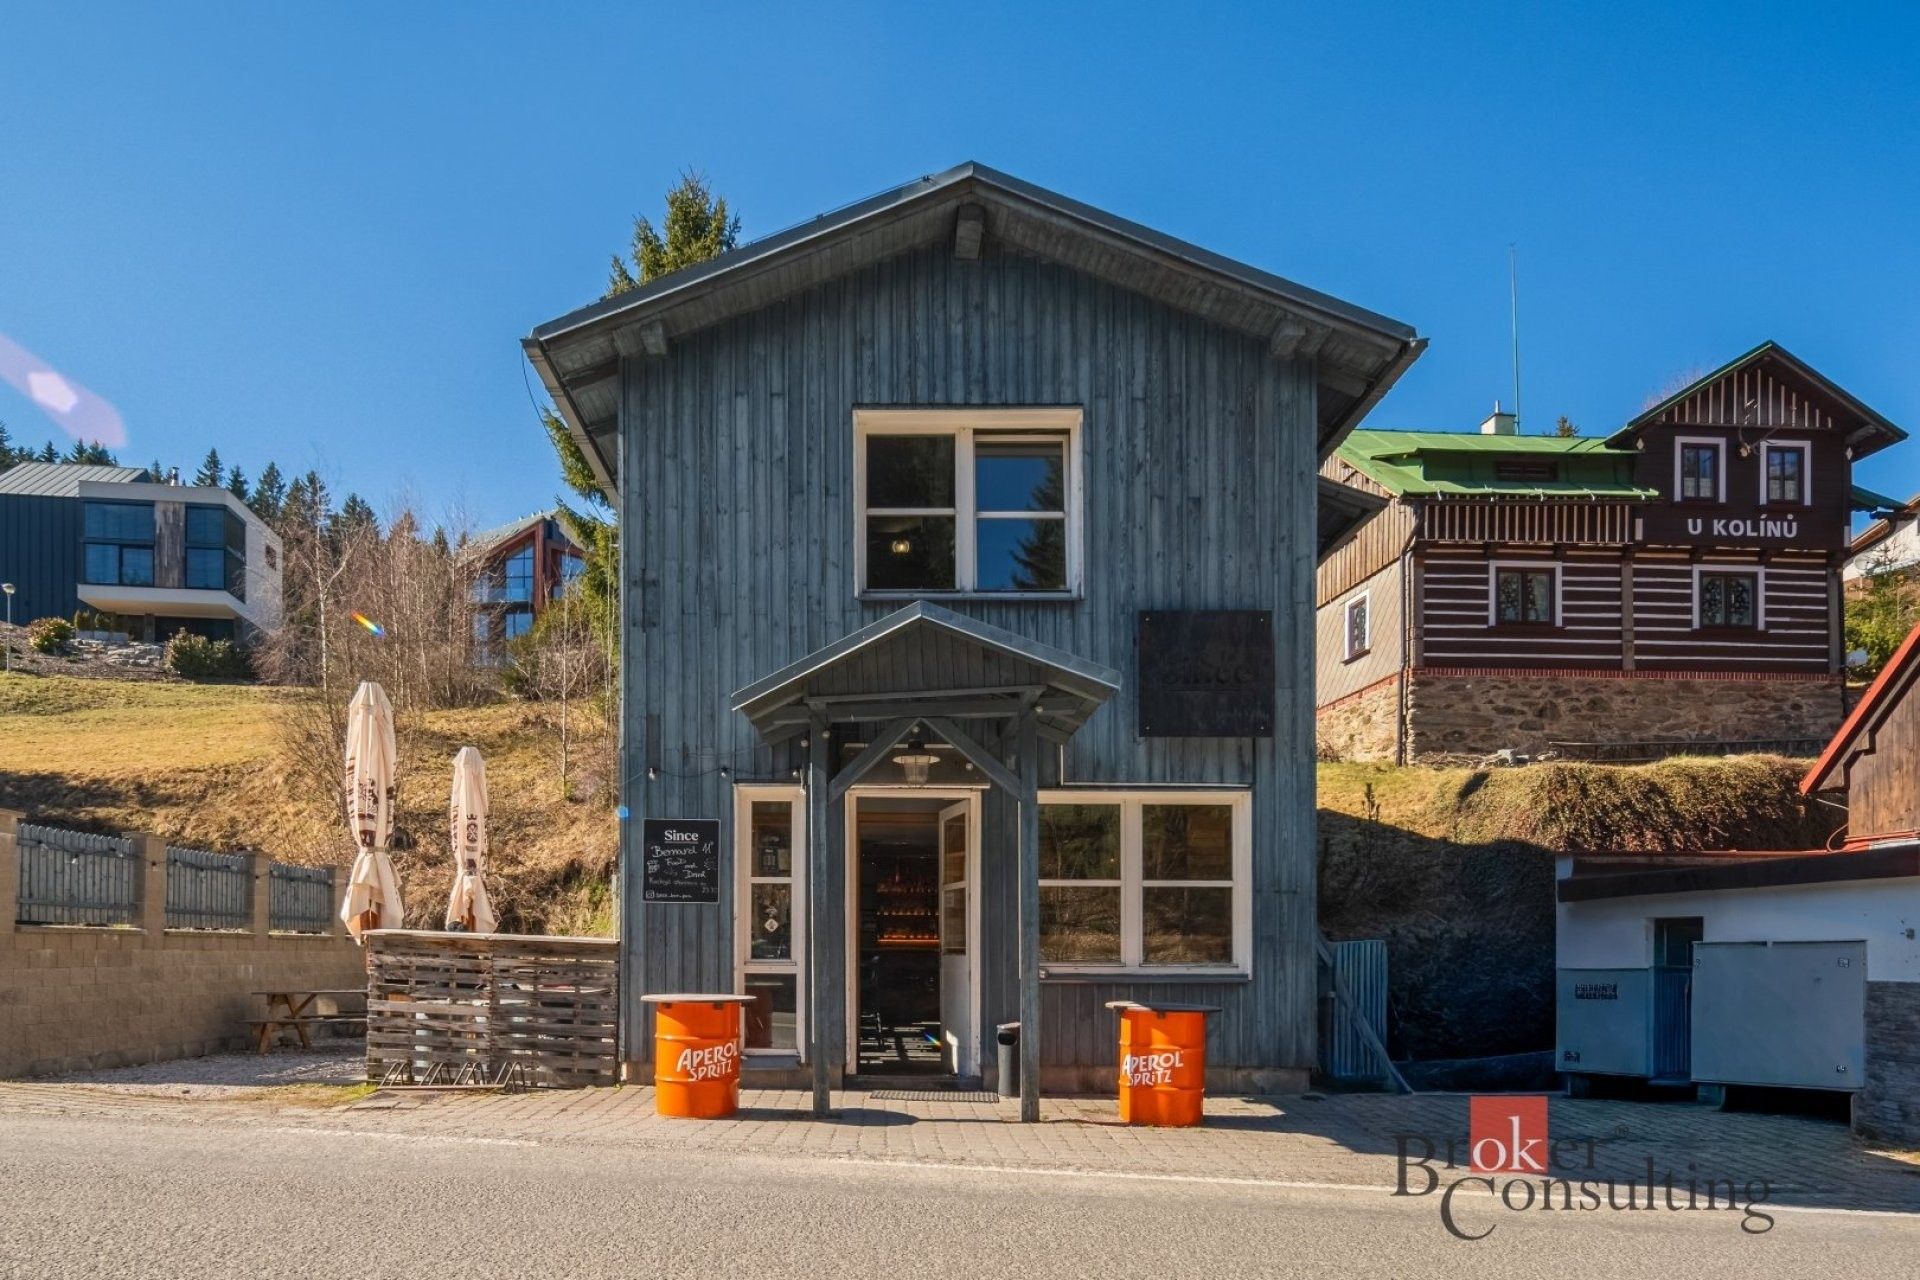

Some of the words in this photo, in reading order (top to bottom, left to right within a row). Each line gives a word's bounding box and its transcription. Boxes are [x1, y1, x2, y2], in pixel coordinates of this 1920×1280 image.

[1687, 518, 1703, 535] U
[1713, 513, 1798, 538] KOLÍNŮ
[664, 829, 699, 841] Since
[1122, 1050, 1184, 1076] APEROL
